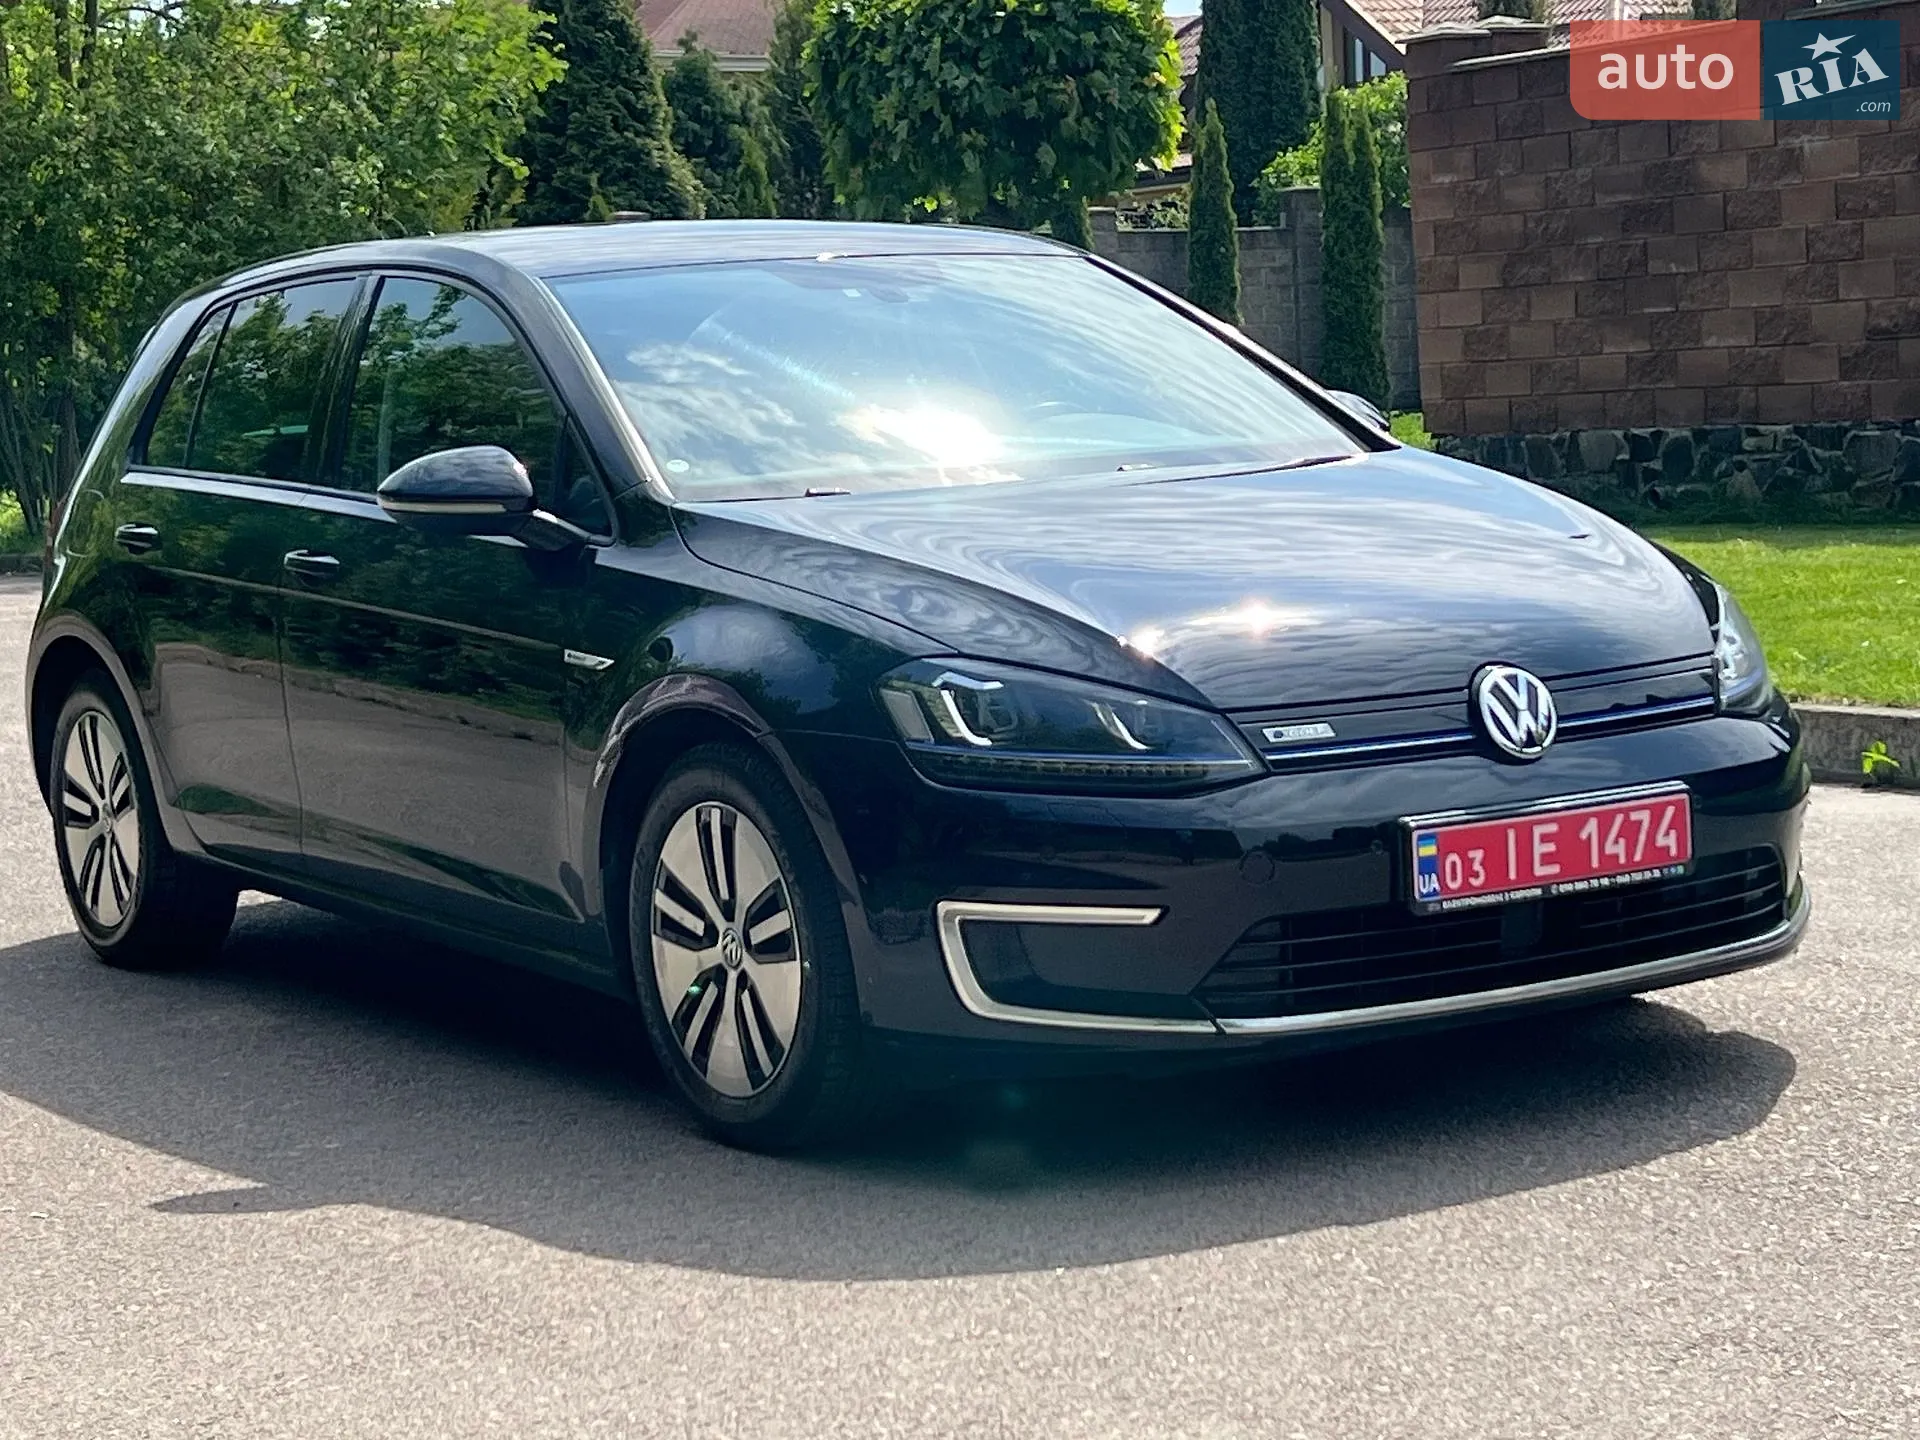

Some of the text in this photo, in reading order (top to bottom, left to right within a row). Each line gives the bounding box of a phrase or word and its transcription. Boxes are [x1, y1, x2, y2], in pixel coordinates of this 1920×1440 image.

[1445, 805, 1677, 890] 03 IE 1474
[1418, 872, 1440, 894] UA
